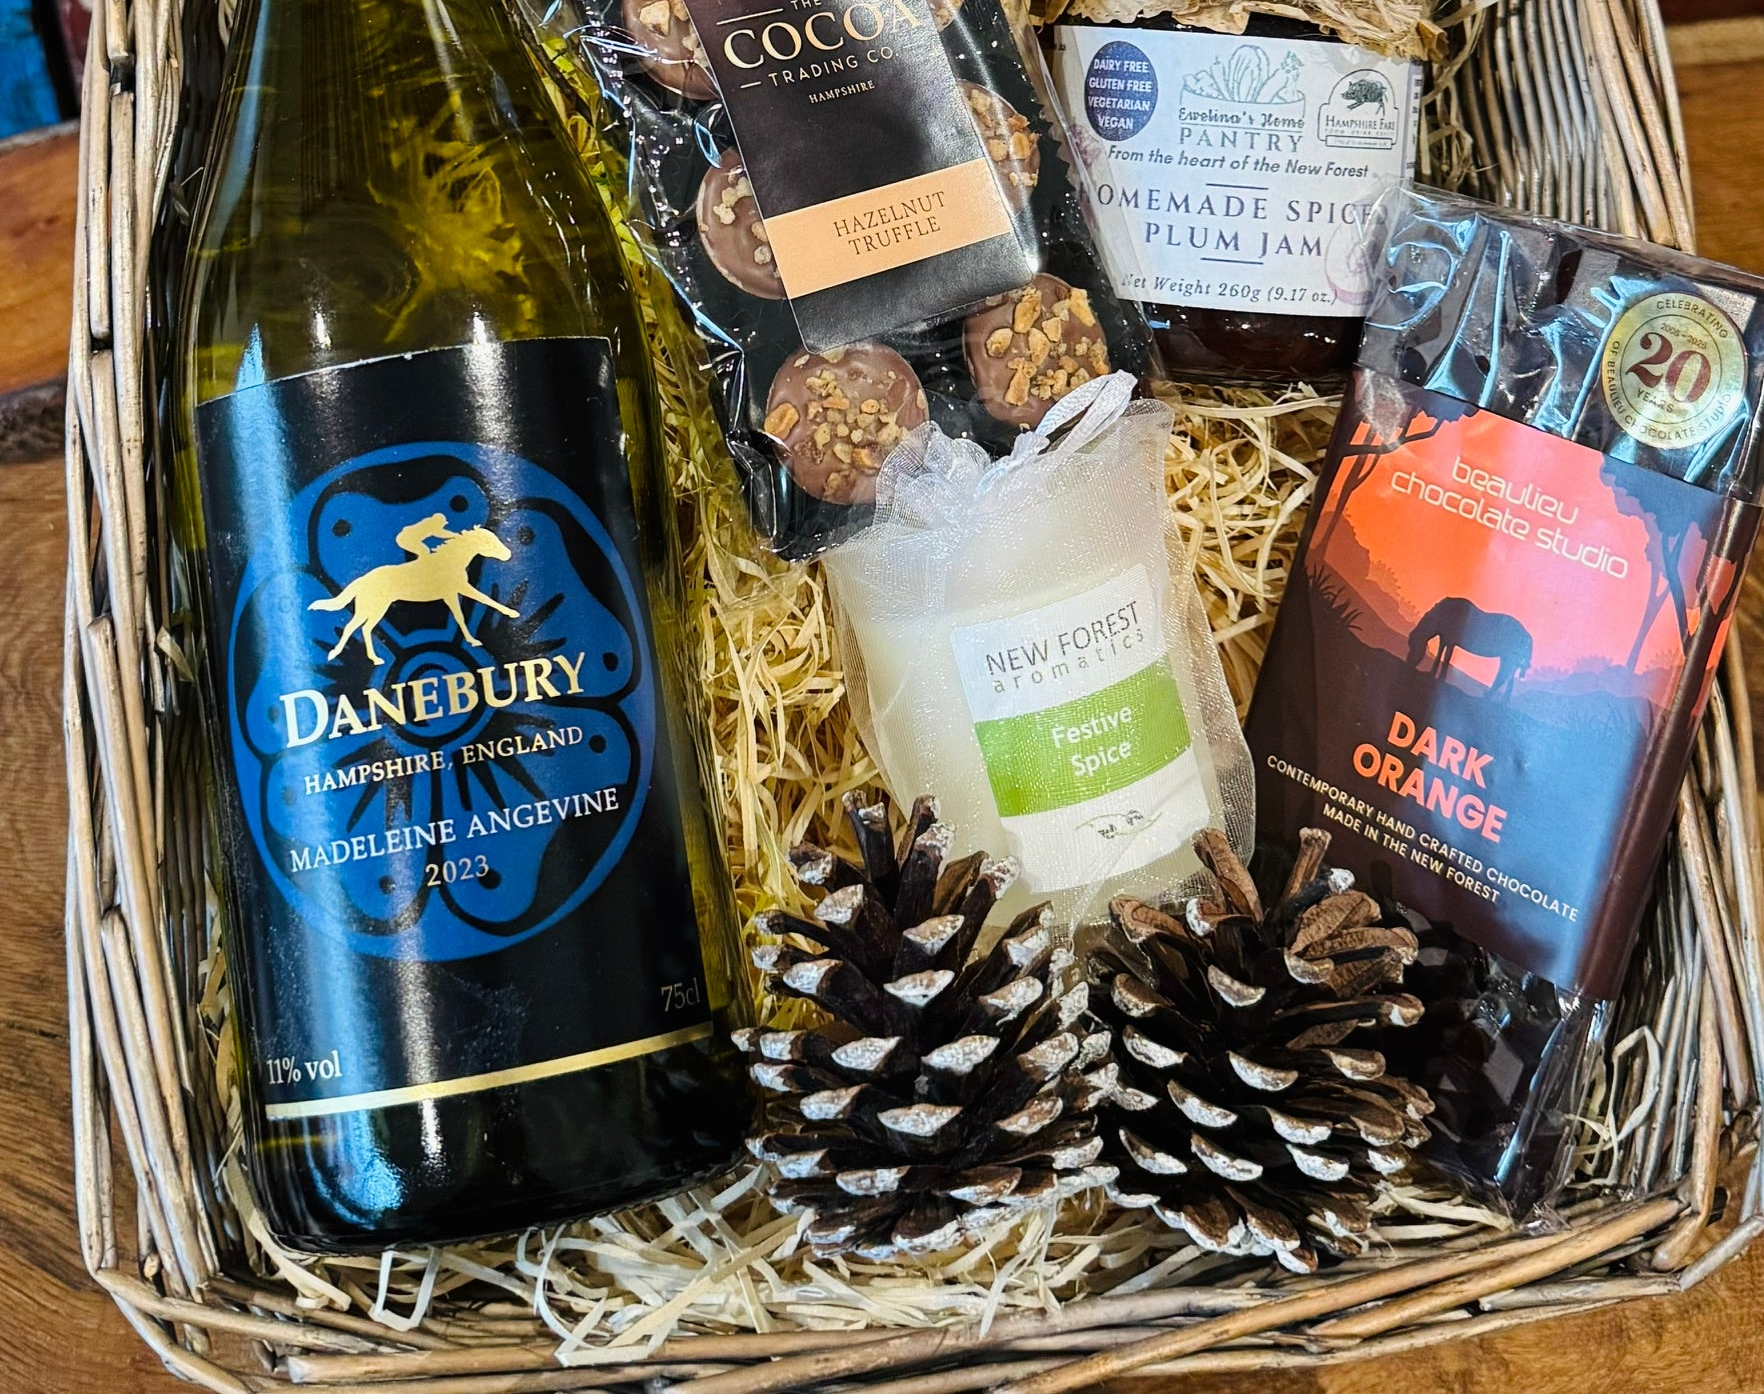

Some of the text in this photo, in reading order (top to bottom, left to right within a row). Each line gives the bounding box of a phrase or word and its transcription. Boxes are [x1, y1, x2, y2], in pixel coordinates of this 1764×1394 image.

[767, 46, 900, 88] TRADING CO.
[1088, 76, 1154, 94] GLUTEN FREE
[1093, 58, 1150, 74] DAIRY FREE
[808, 79, 877, 104] HAMPSHIRE
[1087, 95, 1151, 112] VEGETARIAN
[1097, 115, 1134, 131] VEGAN
[1178, 126, 1305, 154] PANTRY
[1325, 114, 1378, 130] HAMPSHIRE
[1107, 144, 1369, 179] From the heart of the New Forest
[832, 191, 947, 238] HAZELNUT
[1097, 183, 1269, 221] OMEMADE
[847, 215, 942, 257] TRUFFLE
[1143, 221, 1323, 258] PLUM JAM
[1153, 276, 1212, 297] Weight
[1217, 282, 1262, 302] 260g
[1266, 285, 1308, 303] (9.17
[1311, 288, 1339, 306] oz.)
[1655, 299, 1730, 340] CELEBRATING
[1624, 332, 1713, 404] 20
[1605, 339, 1733, 442] OF BEAULIEU CHOCOLATE STUDIO
[1636, 387, 1676, 414] YEARS
[1451, 455, 1580, 526] beaulieu
[1390, 470, 1630, 580] chocolate studio
[986, 600, 1140, 676] NEW FOREST
[994, 632, 1145, 694] aromatics
[278, 651, 587, 749] DANEBURY
[1051, 705, 1133, 749] Festive
[304, 725, 584, 796] HAMPSHIRE, ENGLAND
[1070, 740, 1133, 778] Spice
[1386, 710, 1495, 790] DARK
[1352, 742, 1509, 845] ORANGE
[288, 787, 620, 873] MADELEINE ANGEVINE
[1266, 755, 1581, 923] CONTEMPORARY HAND CRAFTED CHOCOLATE
[424, 855, 491, 888] 2023
[1322, 802, 1501, 904] MADE IN THE NEW FOREST
[660, 977, 702, 1013] 75cl
[265, 1049, 343, 1086] 11% vol
